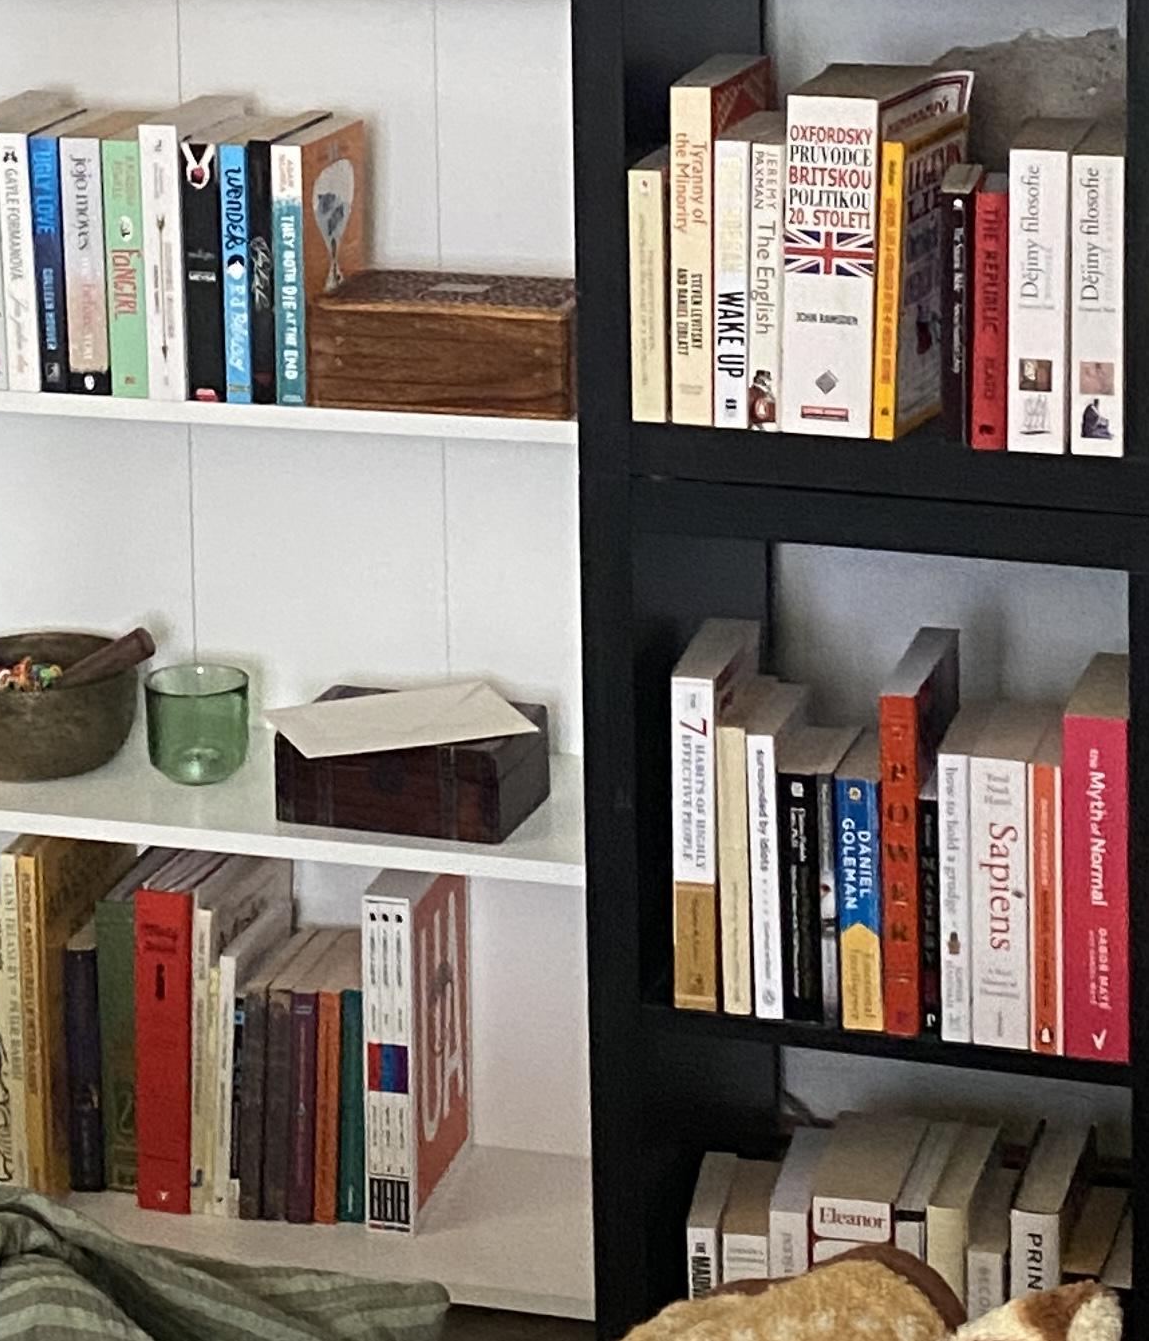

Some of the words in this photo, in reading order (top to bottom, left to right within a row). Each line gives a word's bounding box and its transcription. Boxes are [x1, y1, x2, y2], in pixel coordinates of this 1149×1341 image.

[676, 133, 688, 157] the
[34, 151, 52, 190] UGLY
[70, 155, 90, 191] jojo
[690, 142, 706, 203] Tyranny
[754, 150, 764, 209] PAXMAN
[766, 153, 778, 210] JEREMY
[788, 165, 872, 190] BRITSKOU
[35, 194, 54, 234] LOVE
[223, 167, 243, 250] WONDER
[672, 163, 690, 233] Minority
[692, 208, 707, 225] of
[788, 187, 871, 210] POLITIKOU
[788, 207, 809, 225] 20.
[1020, 165, 1040, 233] filosofie
[1081, 167, 1100, 235] filosofie
[72, 194, 91, 250] moyes
[280, 215, 296, 246] THEY
[756, 221, 775, 261] The
[283, 251, 297, 282] BOTH
[1020, 238, 1044, 299] Dějiny
[1081, 242, 1104, 301] Dějiny
[281, 286, 298, 309] DIE
[691, 274, 703, 305] STEVEN
[751, 267, 776, 335] English
[285, 327, 297, 344] THE
[691, 308, 703, 349] LEVITSKY
[717, 291, 744, 346] WAKE
[283, 350, 298, 380] END
[718, 354, 744, 378] UP
[679, 717, 707, 738] 7
[755, 749, 768, 819] surrounded
[1085, 771, 1107, 821] Myth
[695, 798, 705, 817] OF
[693, 819, 706, 870] HIGHLY
[757, 821, 768, 835] by
[759, 837, 770, 872] idiots
[841, 818, 858, 909] GOLEMAN
[857, 831, 871, 899] DANIEL
[1090, 838, 1108, 906] Normal
[979, 822, 1018, 950] Sapiens
[818, 1206, 887, 1230] Eleanor
